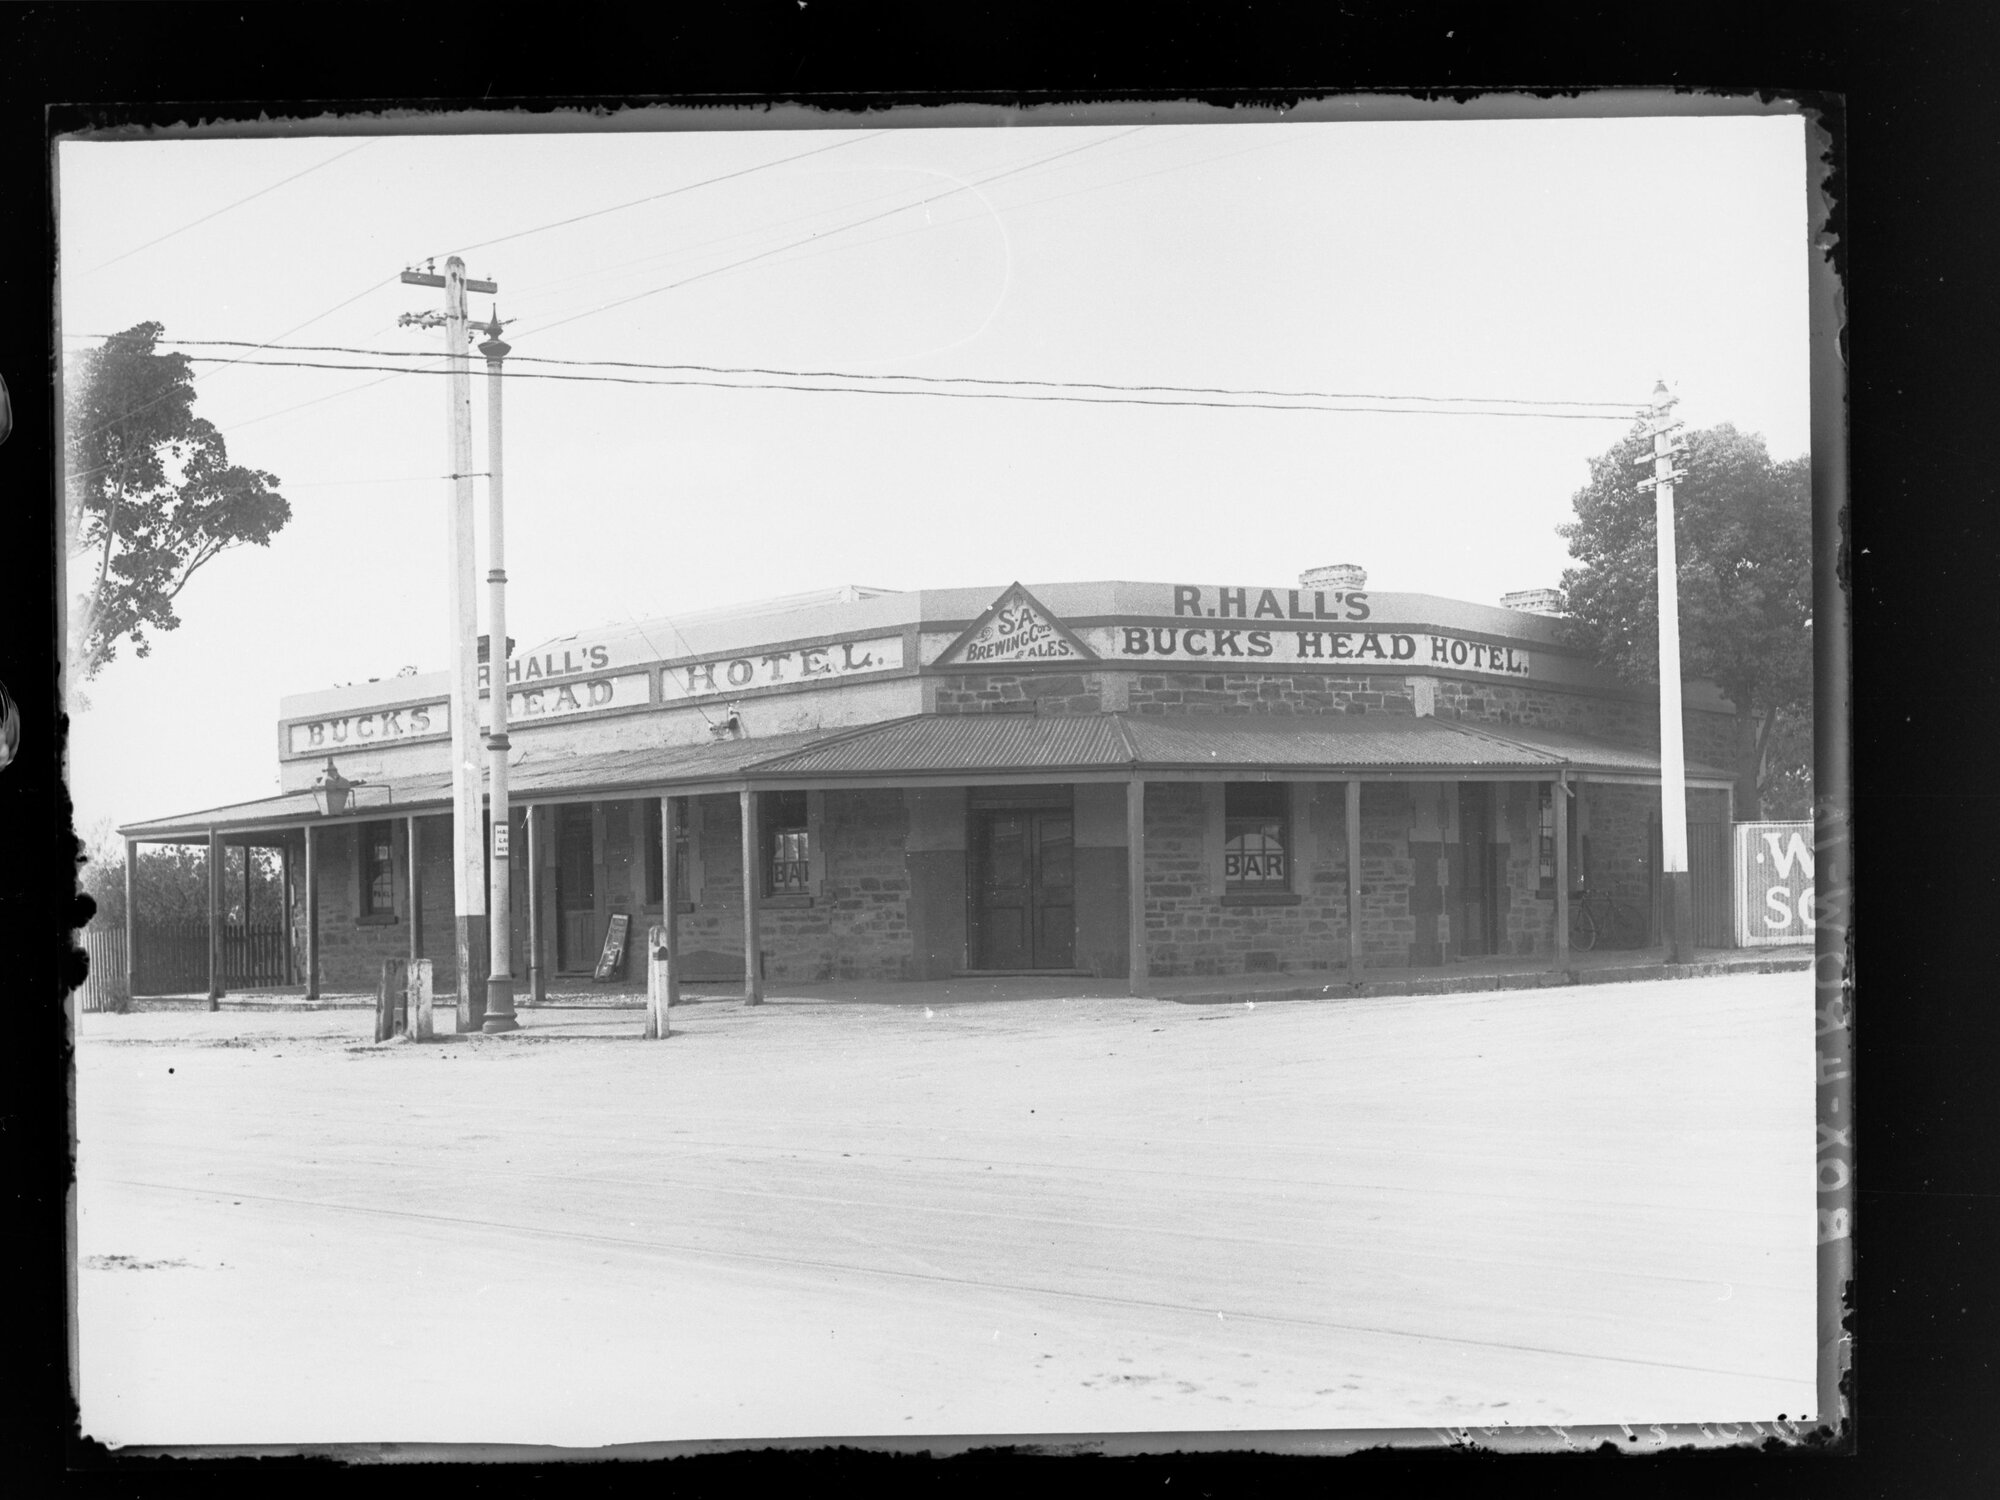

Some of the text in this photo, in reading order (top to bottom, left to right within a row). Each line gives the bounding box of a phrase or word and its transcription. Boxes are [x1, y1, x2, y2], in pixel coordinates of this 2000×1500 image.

[1121, 626, 1529, 674] BUCKS HEAD HOTEL.
[308, 706, 431, 747] BUCKS
[685, 643, 885, 691] HOTEL.
[1225, 854, 1283, 876] BAR
